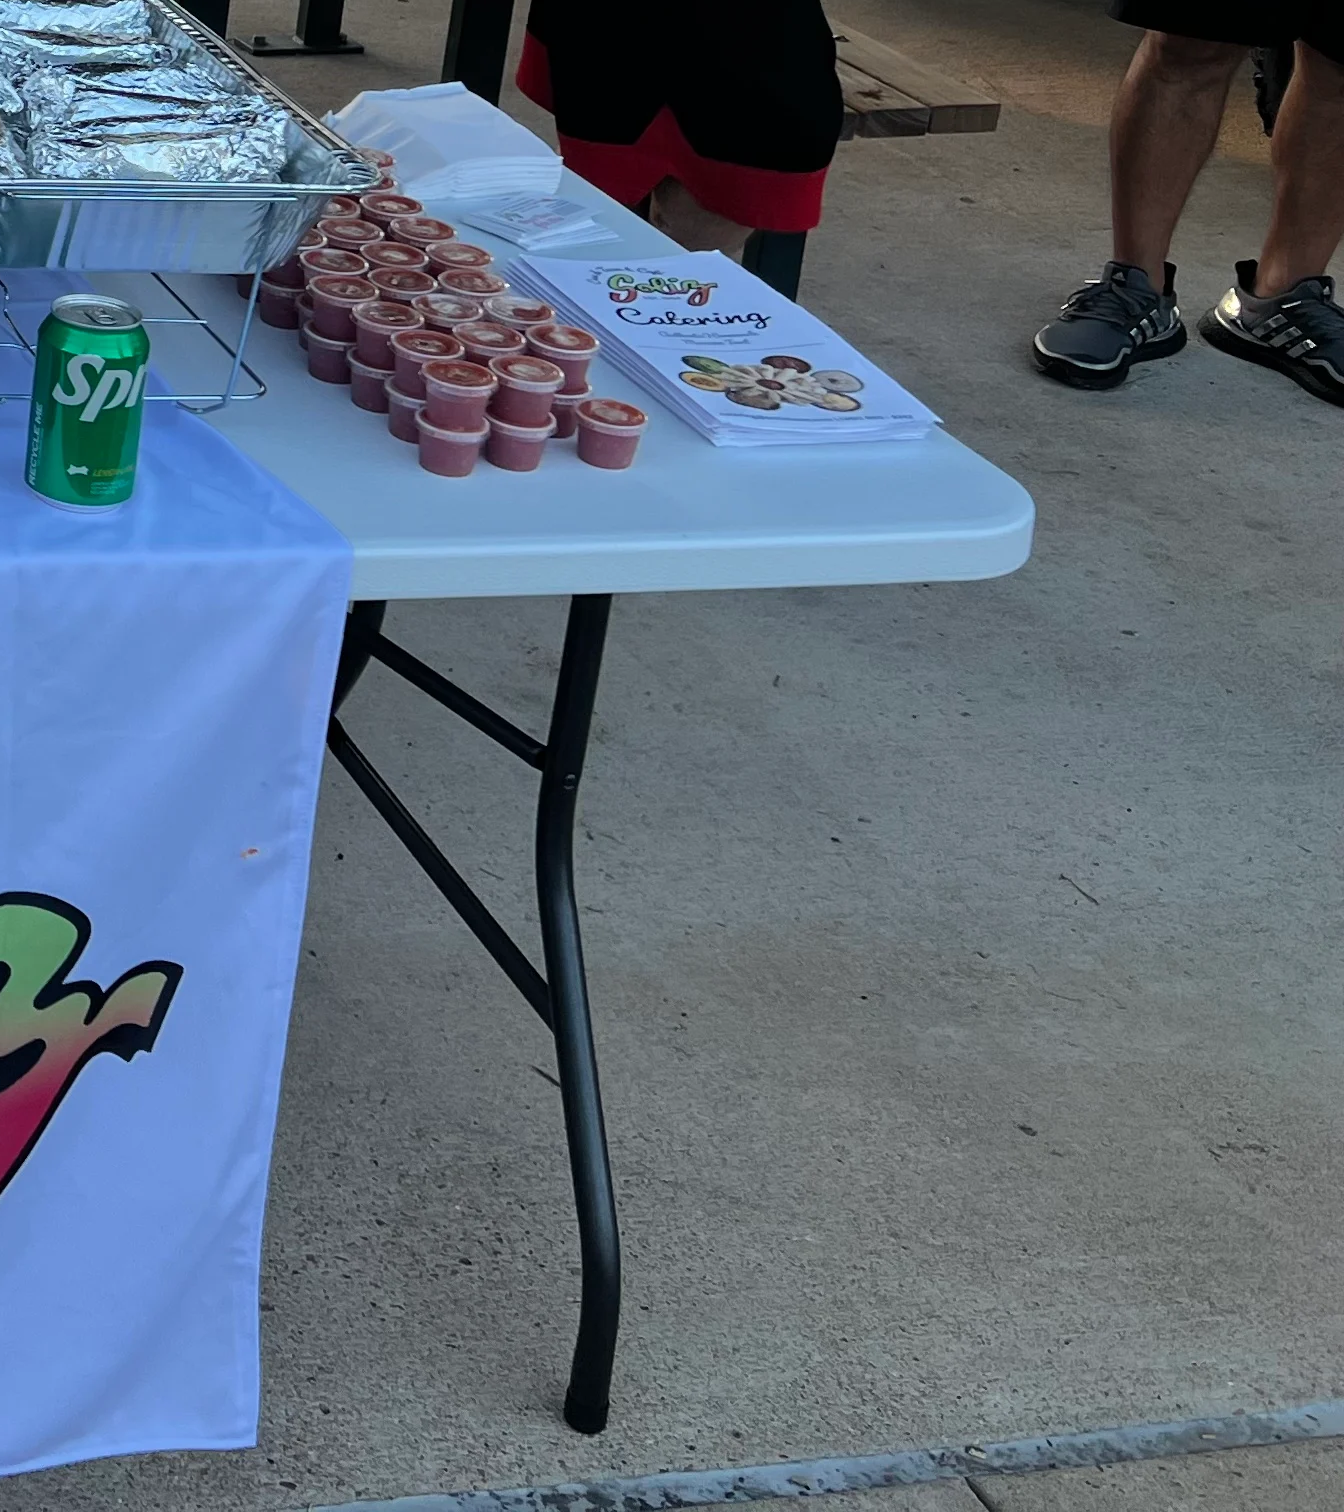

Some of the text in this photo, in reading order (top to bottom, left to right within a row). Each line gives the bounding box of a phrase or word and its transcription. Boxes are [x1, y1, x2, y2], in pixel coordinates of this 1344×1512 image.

[607, 273, 718, 306] Soliz
[615, 307, 772, 330] Catering
[27, 402, 45, 486] RECYCLE ME
